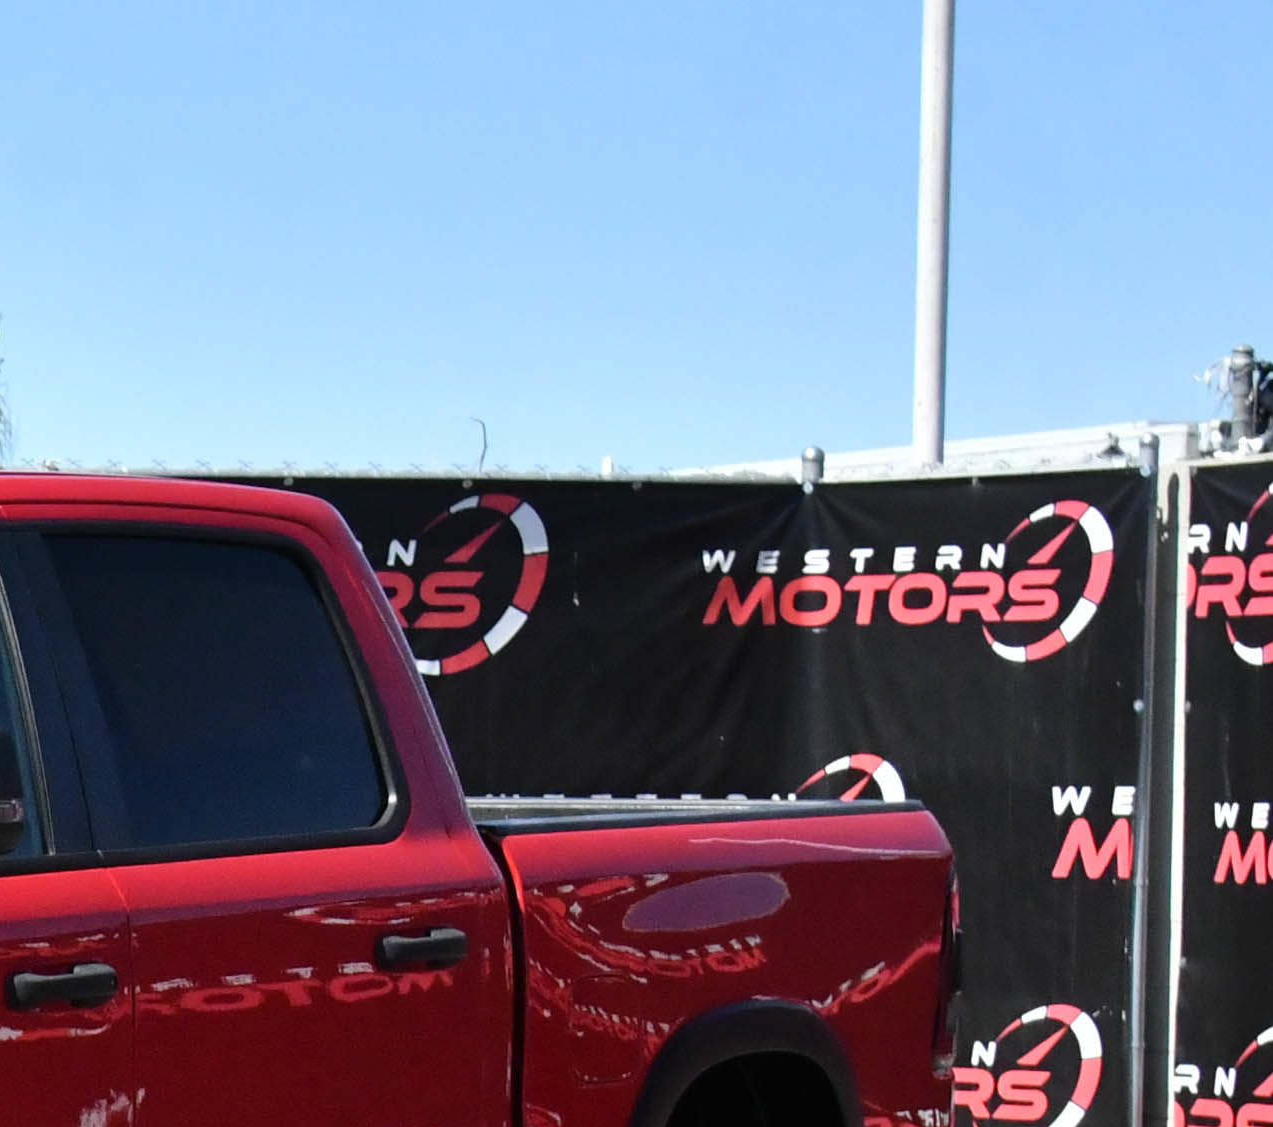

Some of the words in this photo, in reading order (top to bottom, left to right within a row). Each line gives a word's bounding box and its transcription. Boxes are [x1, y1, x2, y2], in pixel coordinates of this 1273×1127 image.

[702, 543, 1006, 574] WESTERN
[703, 568, 1062, 627] MOTORS
[1213, 830, 1273, 884] M
